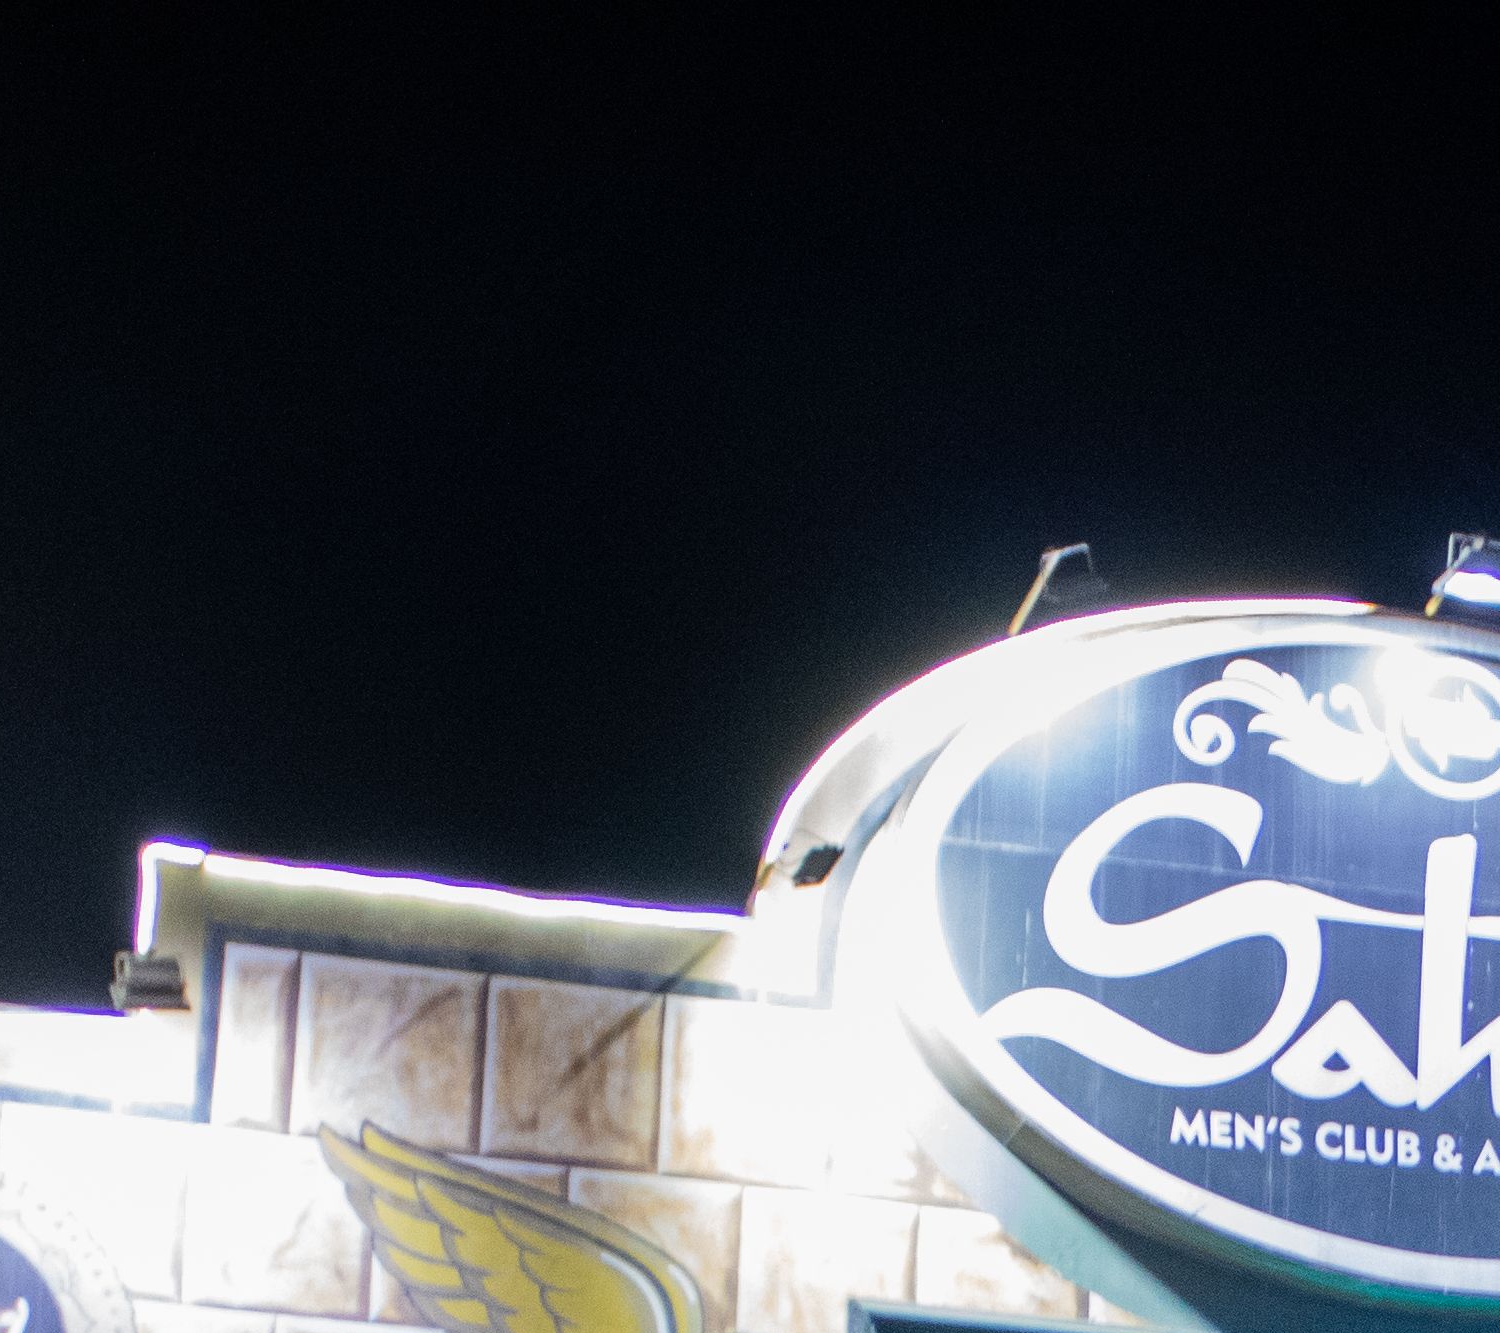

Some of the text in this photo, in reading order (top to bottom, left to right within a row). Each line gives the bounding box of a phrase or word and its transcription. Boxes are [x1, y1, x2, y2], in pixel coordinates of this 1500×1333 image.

[1169, 1106, 1302, 1156] MEN'S
[1315, 1121, 1421, 1167] CLUB
[1432, 1133, 1463, 1172] &
